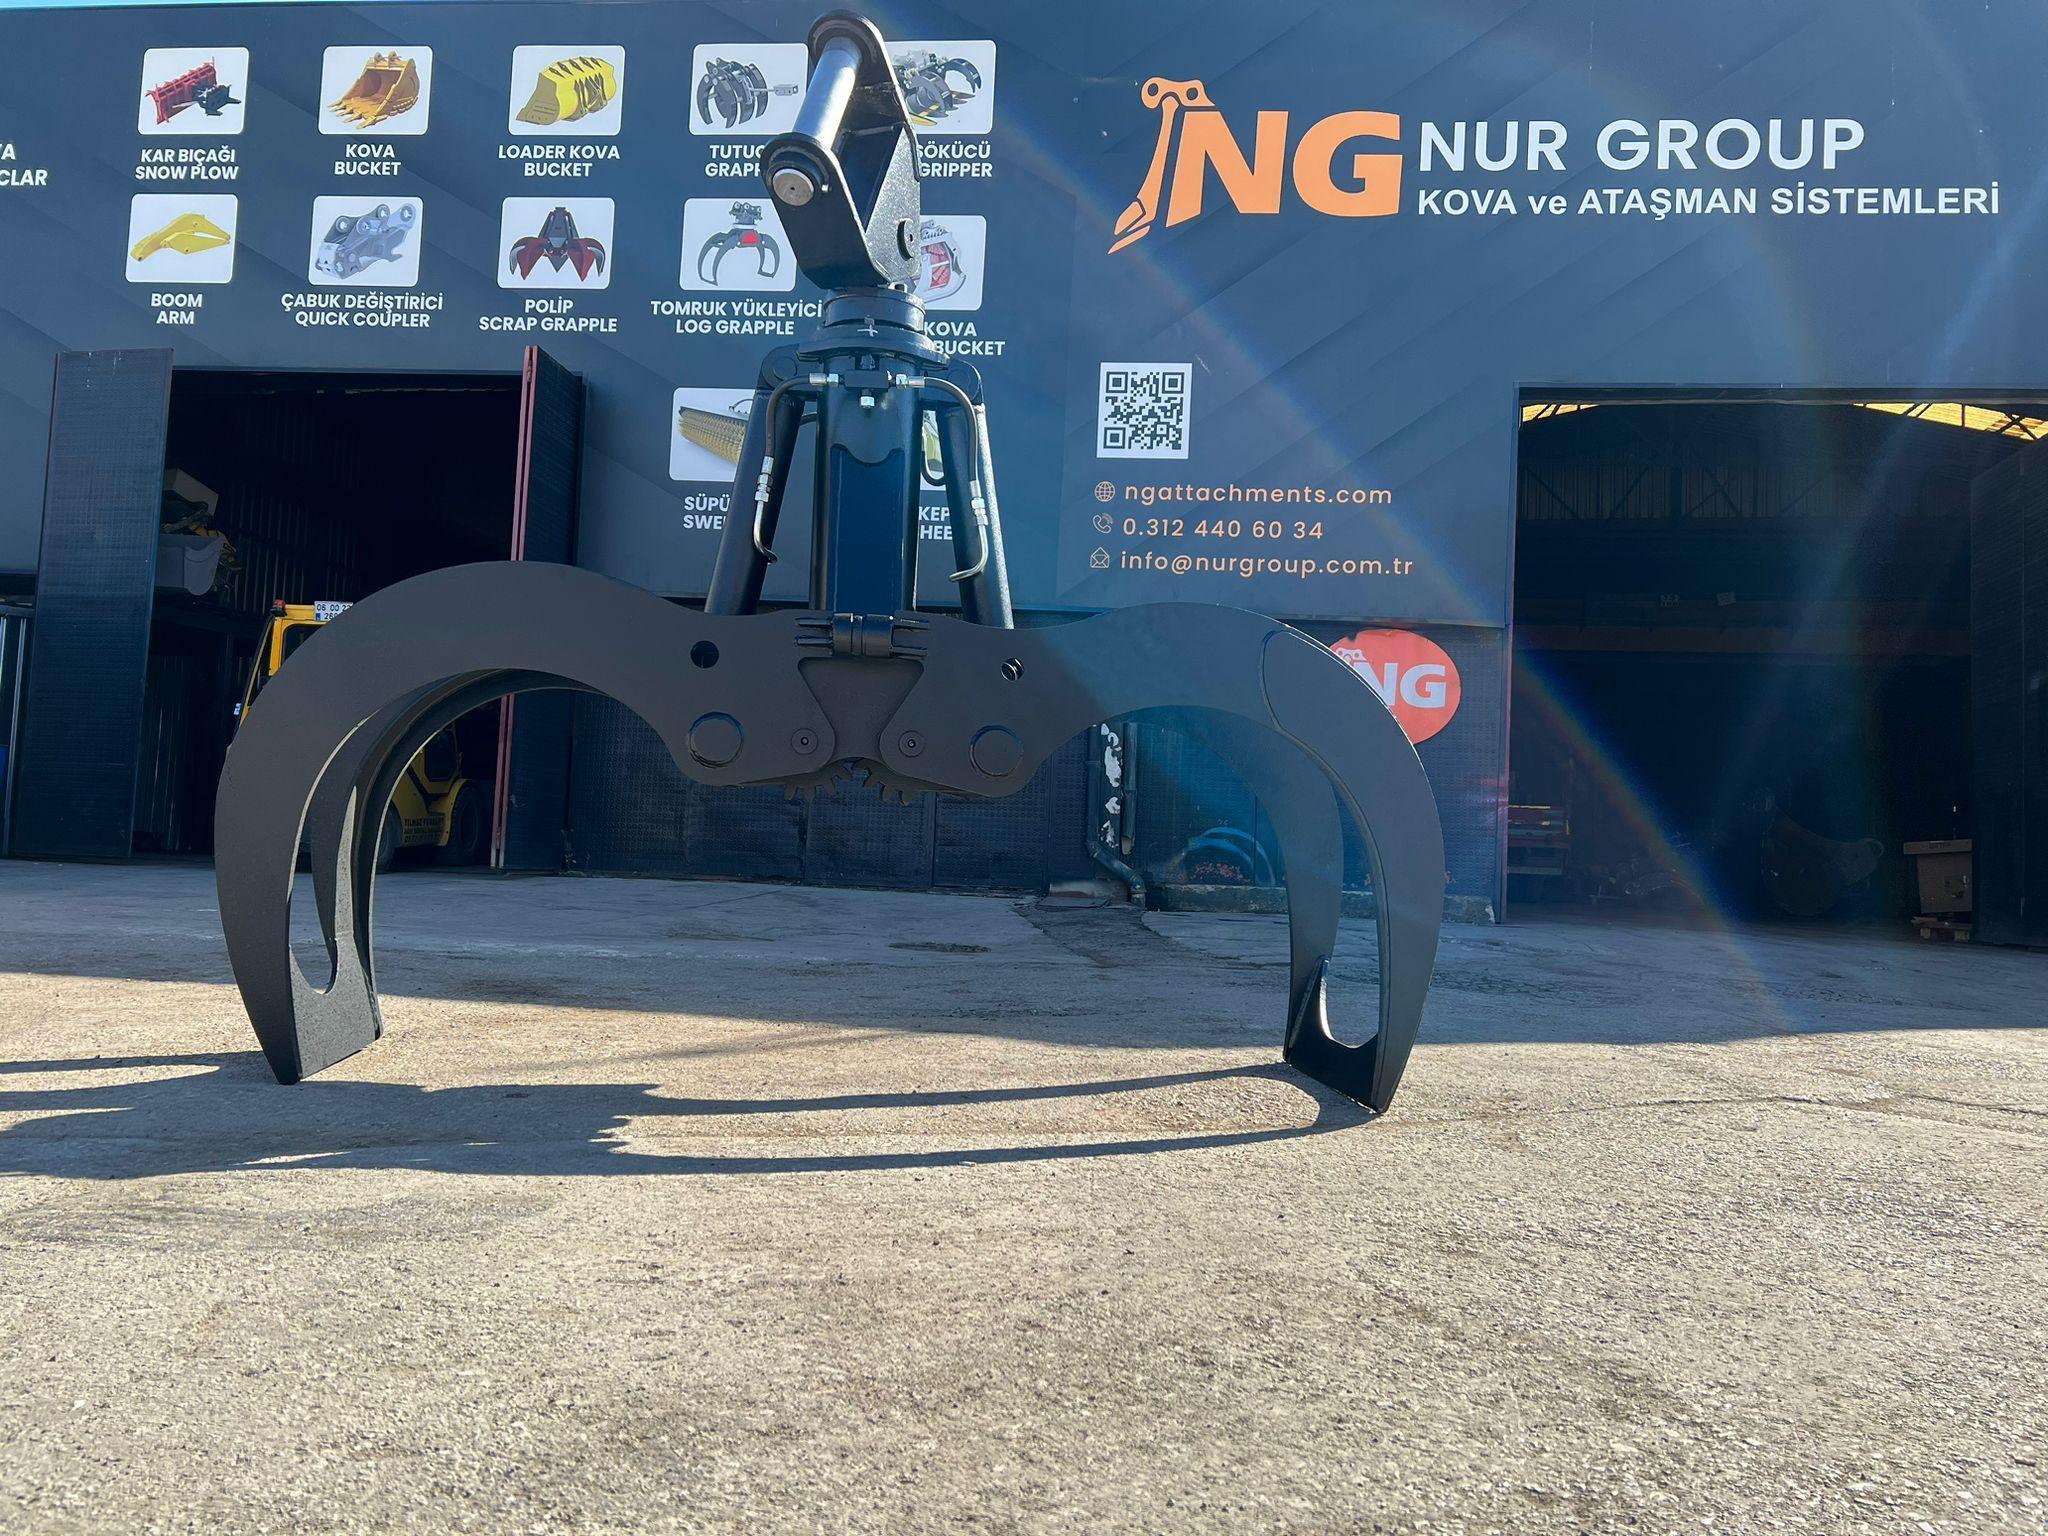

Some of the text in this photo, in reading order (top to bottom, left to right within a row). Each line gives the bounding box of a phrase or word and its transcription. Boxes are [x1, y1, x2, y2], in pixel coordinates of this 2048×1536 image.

[0, 143, 16, 160] A
[345, 143, 396, 158] KOVA
[498, 144, 621, 160] LOADER KOVA
[1419, 118, 1866, 172] NUR GROUP
[140, 145, 236, 167] KAR BIÇAĞI
[135, 165, 240, 180] SNOW PLOW
[334, 161, 401, 176] BUCKET
[523, 162, 593, 177] BUCKET
[920, 162, 993, 178] GRIPPER
[1166, 110, 1404, 228] NG
[0, 169, 48, 186] CLAR
[1418, 181, 2000, 222] KOVA ve ATAŞMAN SİSTEMLERİ
[150, 293, 203, 308] BOOM
[281, 293, 341, 312] ÇABUK
[524, 296, 574, 314] POLİP
[650, 298, 823, 318] TOMRUK YÜKLEYİCİ
[156, 310, 195, 325] ARM
[295, 310, 431, 328] QUICK COUPLER
[478, 316, 618, 333] SCRAP GRAPPLE
[676, 319, 795, 336] LOG GRAPPLE
[923, 321, 978, 337] KOVA
[933, 340, 1006, 356] BUCKET
[684, 493, 731, 512] SÜPÜ
[1124, 484, 1393, 506] ngattachments.com
[919, 506, 950, 522] KEP
[920, 524, 953, 541] HEE
[1122, 518, 1324, 540] 0.312 440 60 34
[1120, 551, 1413, 579] info@nurgroup.com.tr
[1352, 662, 1447, 709] NG
